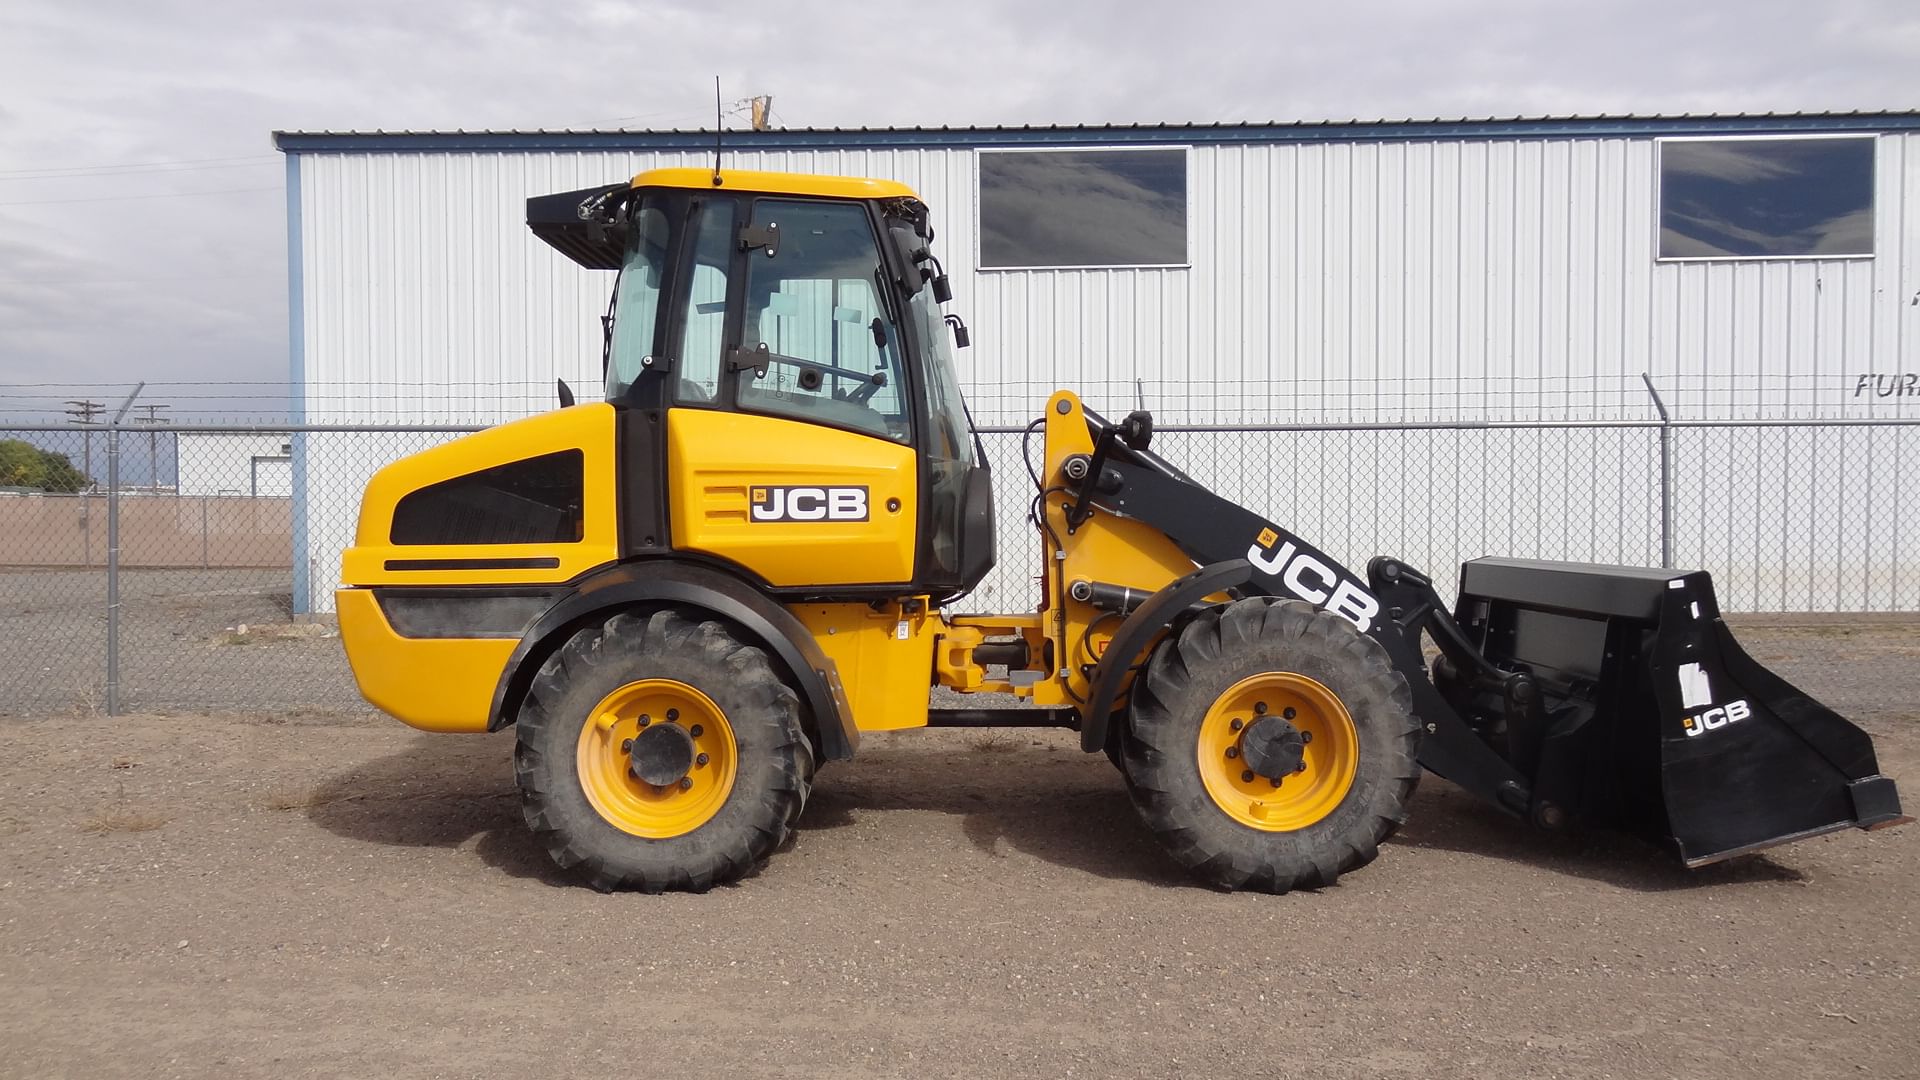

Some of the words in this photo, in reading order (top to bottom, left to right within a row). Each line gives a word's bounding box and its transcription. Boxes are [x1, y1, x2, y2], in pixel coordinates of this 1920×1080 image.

[1854, 374, 1920, 397] FUR
[753, 488, 867, 520] JCB
[1247, 541, 1379, 633] JCB
[1685, 700, 1751, 737] JCB
